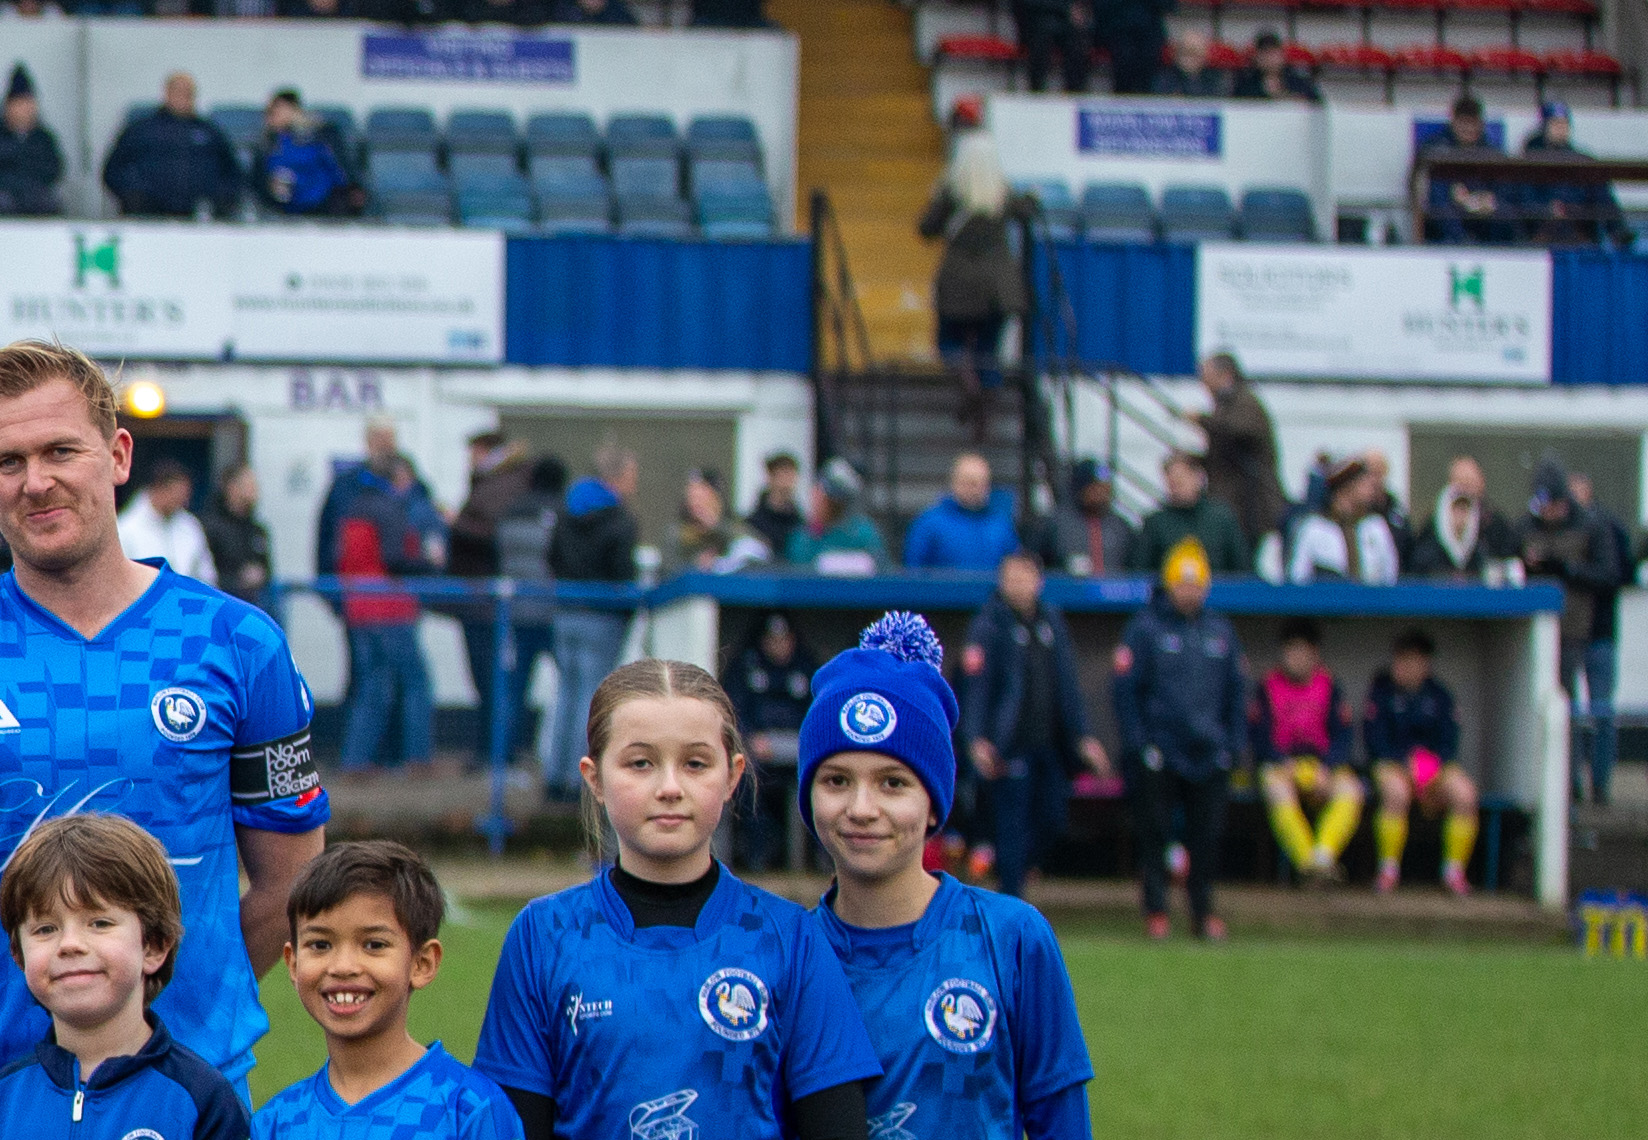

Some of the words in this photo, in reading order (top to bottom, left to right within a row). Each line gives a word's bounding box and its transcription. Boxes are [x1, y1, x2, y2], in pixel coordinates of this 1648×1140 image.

[288, 369, 386, 413] BAR
[265, 744, 294, 760] No
[269, 748, 312, 772] room
[270, 769, 296, 788] for
[270, 770, 321, 799] racism
